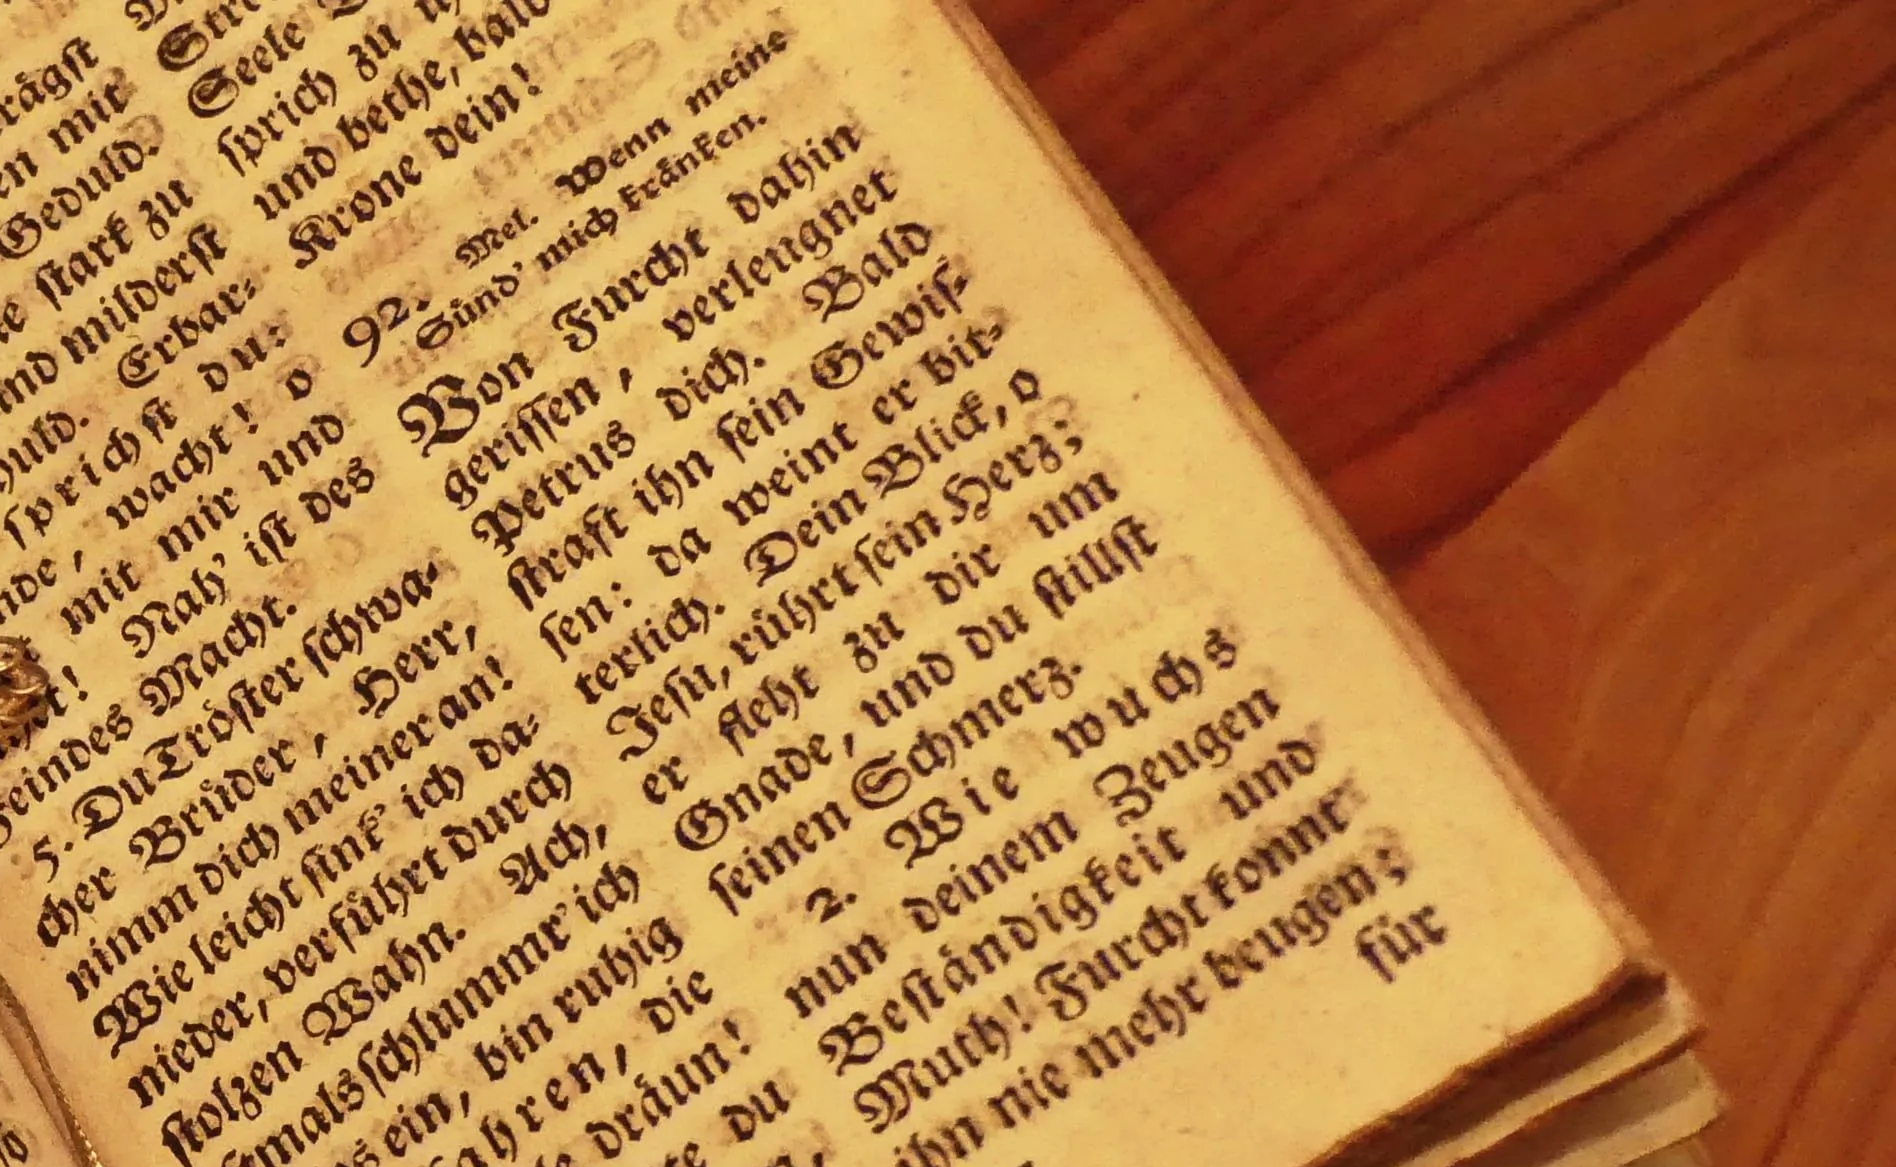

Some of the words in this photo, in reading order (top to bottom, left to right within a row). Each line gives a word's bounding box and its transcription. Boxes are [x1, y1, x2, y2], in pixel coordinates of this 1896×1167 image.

[347, 23, 402, 82] zu
[47, 66, 129, 154] mit
[138, 178, 195, 241] zu
[253, 144, 338, 221] und
[726, 124, 862, 224] dahin
[535, 205, 620, 272] mich
[661, 168, 898, 342] verleugnet
[60, 558, 142, 635] mit
[156, 485, 240, 562] mir
[257, 413, 345, 486] und
[298, 455, 376, 524] des
[631, 449, 715, 516] ihn
[647, 526, 713, 577] da
[721, 420, 859, 527] weint
[872, 377, 918, 425] er
[642, 755, 689, 805] er
[718, 664, 820, 757] fleht
[843, 610, 906, 673] zu
[923, 542, 1001, 605] dir
[1027, 471, 1120, 539] um
[860, 651, 956, 728] und
[956, 603, 1030, 660] du
[440, 759, 573, 863] durch
[1220, 739, 1317, 820] und
[65, 883, 199, 1002] nimm
[193, 821, 281, 896] dich
[283, 712, 435, 835] meiner
[188, 877, 303, 975] leicht
[400, 762, 466, 820] ich
[572, 861, 641, 924] ich
[784, 932, 889, 1019] nun
[901, 810, 1079, 933] deinem
[473, 1012, 555, 1082] bin
[552, 915, 685, 1024] ruhig
[639, 969, 714, 1034] die
[987, 1061, 1070, 1129] nie
[1074, 974, 1208, 1079] mehr
[719, 1079, 791, 1143] du
